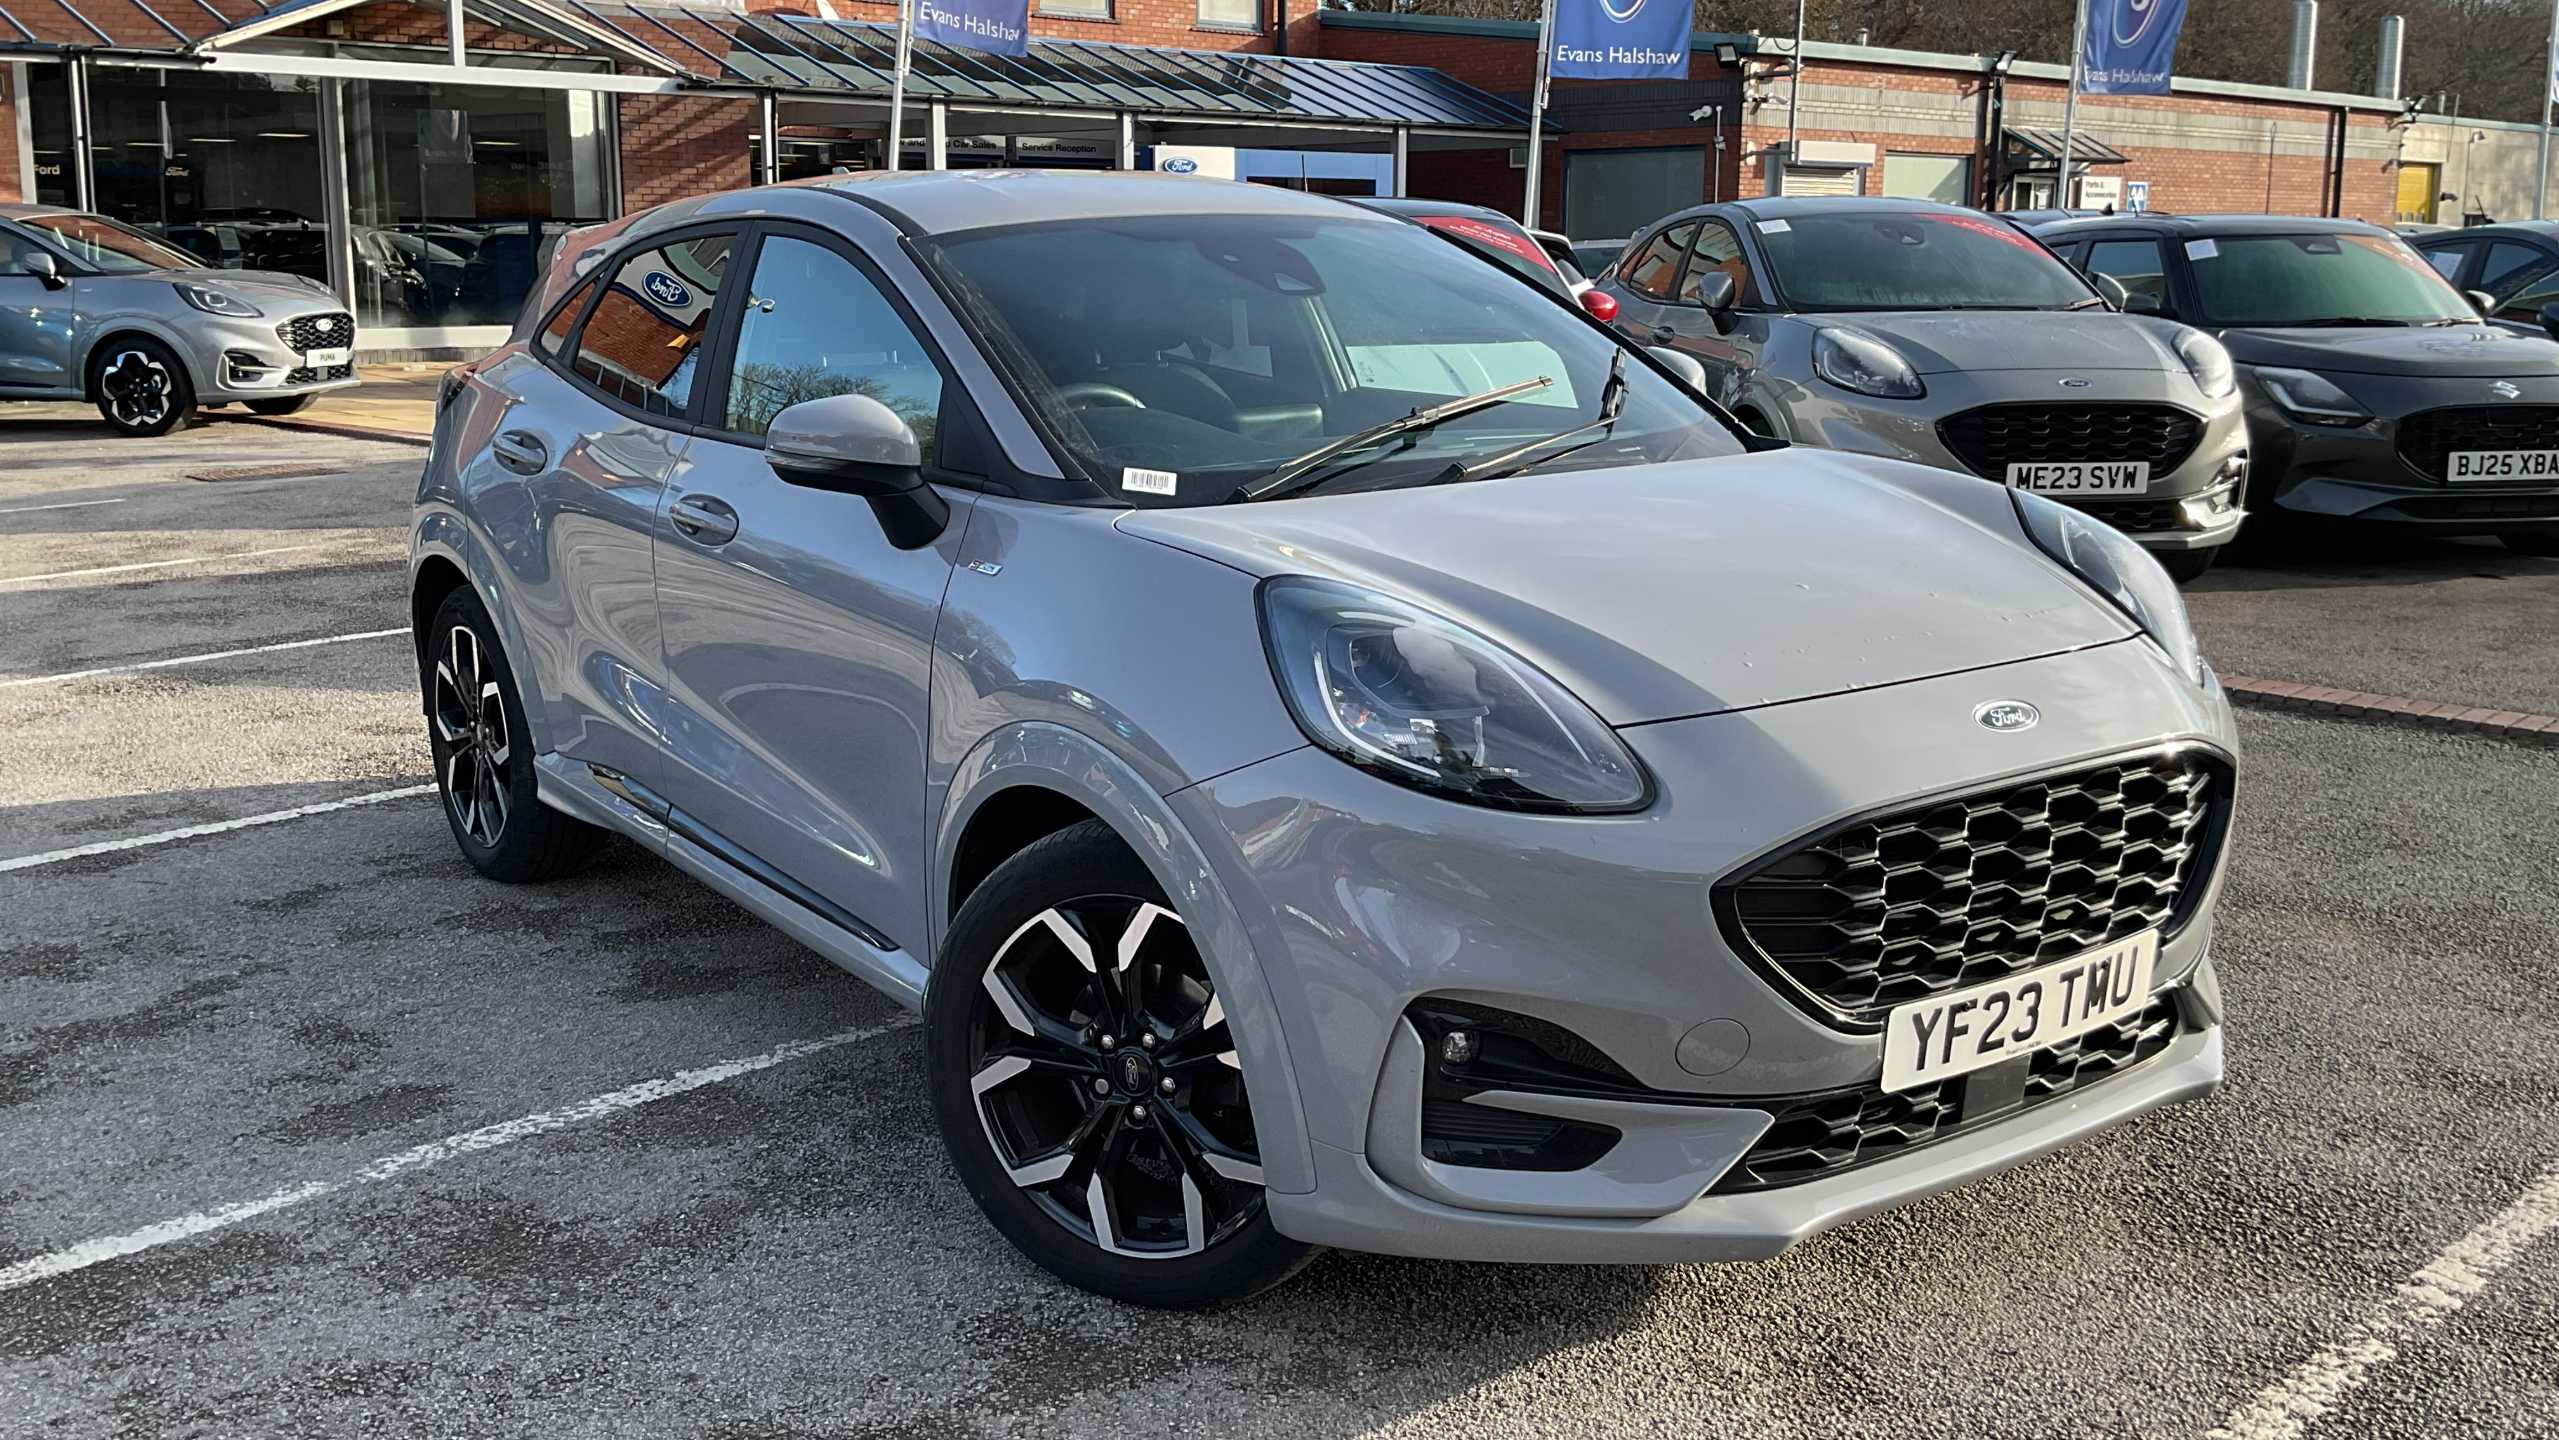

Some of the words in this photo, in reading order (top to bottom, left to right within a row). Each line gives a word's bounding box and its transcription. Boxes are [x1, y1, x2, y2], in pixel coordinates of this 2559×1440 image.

[920, 1, 960, 28] Evans
[964, 13, 1020, 41] Halshaw
[1556, 45, 1603, 62] Evans
[1608, 46, 1681, 65] Halshaw
[953, 139, 969, 149] Car
[972, 139, 997, 149] Sales
[1022, 142, 1054, 152] Service
[1055, 143, 1097, 154] Reception
[33, 164, 61, 175] Ford
[2456, 455, 2513, 476] BJ25
[2519, 453, 2559, 475] XBA
[2015, 466, 2082, 490] ME23
[2089, 465, 2138, 489] SVW
[1990, 706, 2026, 727] Ford
[1912, 981, 2042, 1071] YF23
[2059, 946, 2139, 1028] TMU
